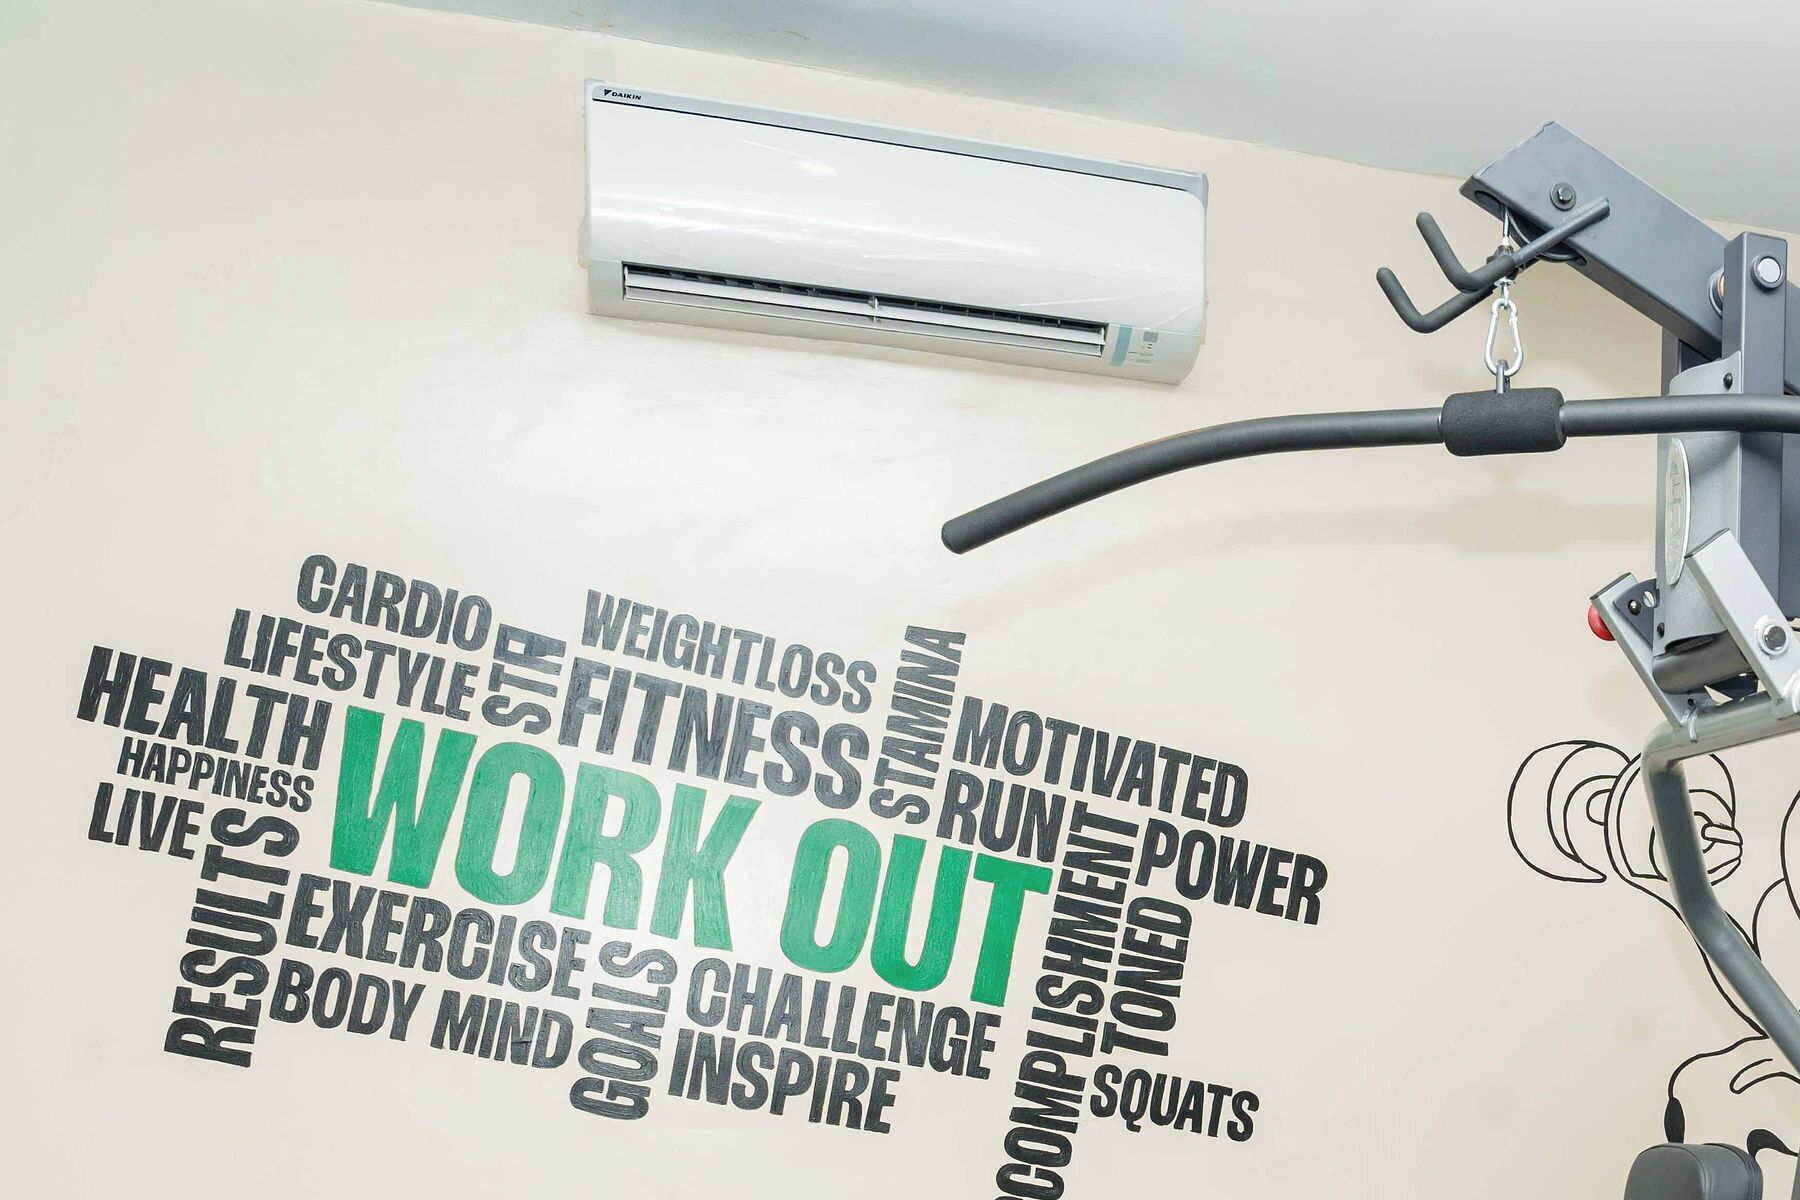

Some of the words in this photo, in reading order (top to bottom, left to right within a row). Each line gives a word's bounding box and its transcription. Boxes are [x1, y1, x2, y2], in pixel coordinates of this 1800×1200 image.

[611, 91, 642, 101] DAIKIN
[296, 554, 492, 651] CARDIO
[581, 588, 877, 713] WEIGHTLOSS
[76, 645, 332, 771] HEALTH
[223, 608, 479, 721] LIFESTYLE
[868, 625, 966, 824] STAMINA
[116, 736, 315, 813] HAPPINESS
[558, 656, 870, 810] FITNESS
[952, 695, 1249, 828] MOTIVATED
[88, 782, 204, 860] LIVE
[329, 705, 762, 951] WORK
[779, 818, 1054, 1007] OUT
[937, 768, 1067, 862] RUN
[1135, 818, 1328, 925] POWER
[164, 807, 300, 1068] RESULTS
[285, 873, 591, 1000] EXERCISE
[1100, 896, 1192, 1056] TONED
[269, 959, 426, 1041] BODY
[430, 990, 574, 1069] MIND
[569, 940, 678, 1120] GOALS
[686, 958, 1002, 1080] CHALLENGE
[668, 1029, 900, 1134] INSPIRE
[1090, 1064, 1260, 1142] SQUATS
